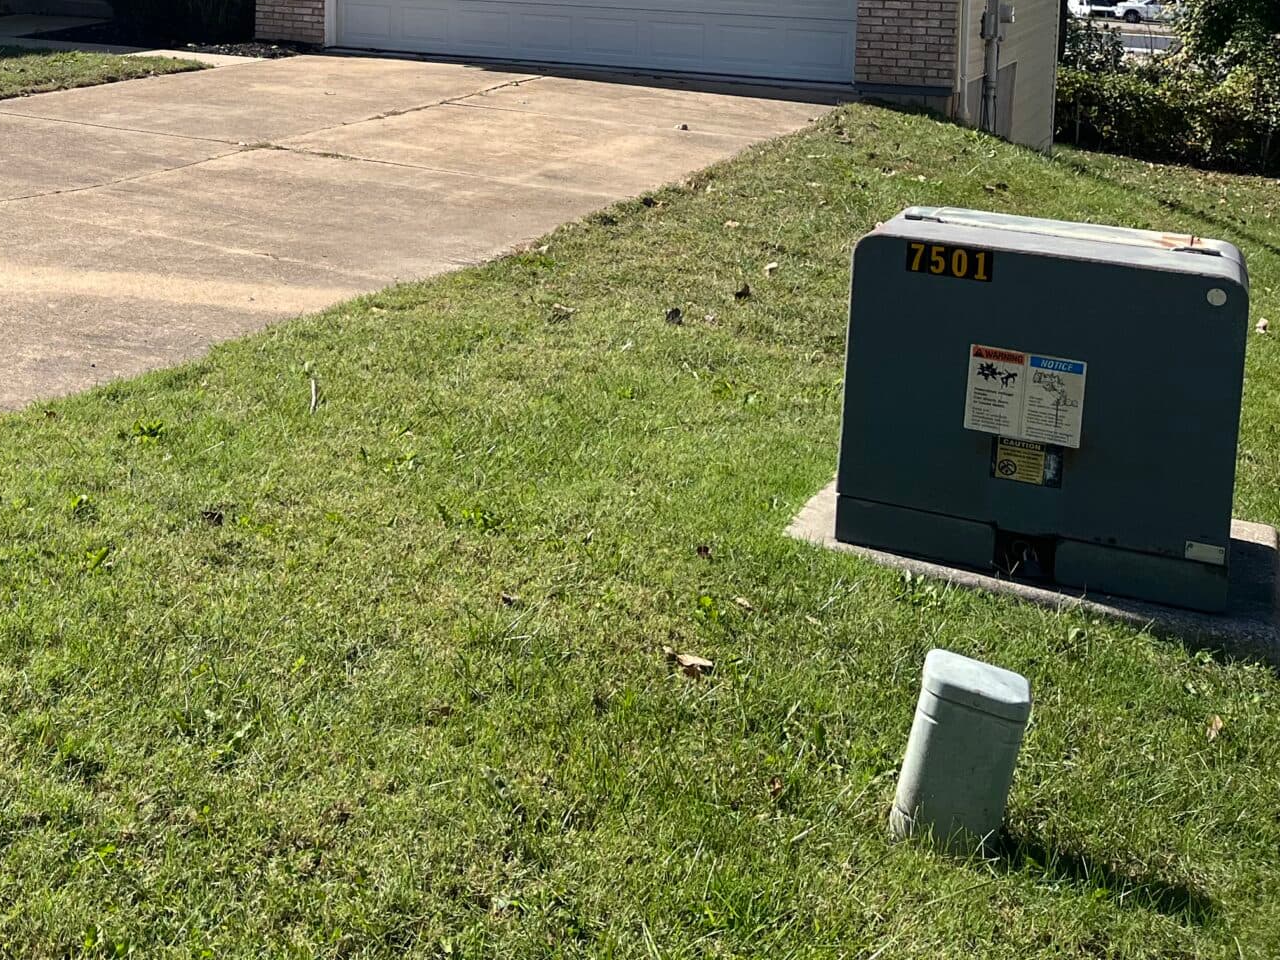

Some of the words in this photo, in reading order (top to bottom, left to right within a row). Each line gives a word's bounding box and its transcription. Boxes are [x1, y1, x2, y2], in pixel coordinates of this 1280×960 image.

[910, 242, 988, 280] 7501
[984, 350, 1024, 364] WARNING
[1040, 359, 1074, 371] NOTICE
[1003, 438, 1041, 451] CAUTION
